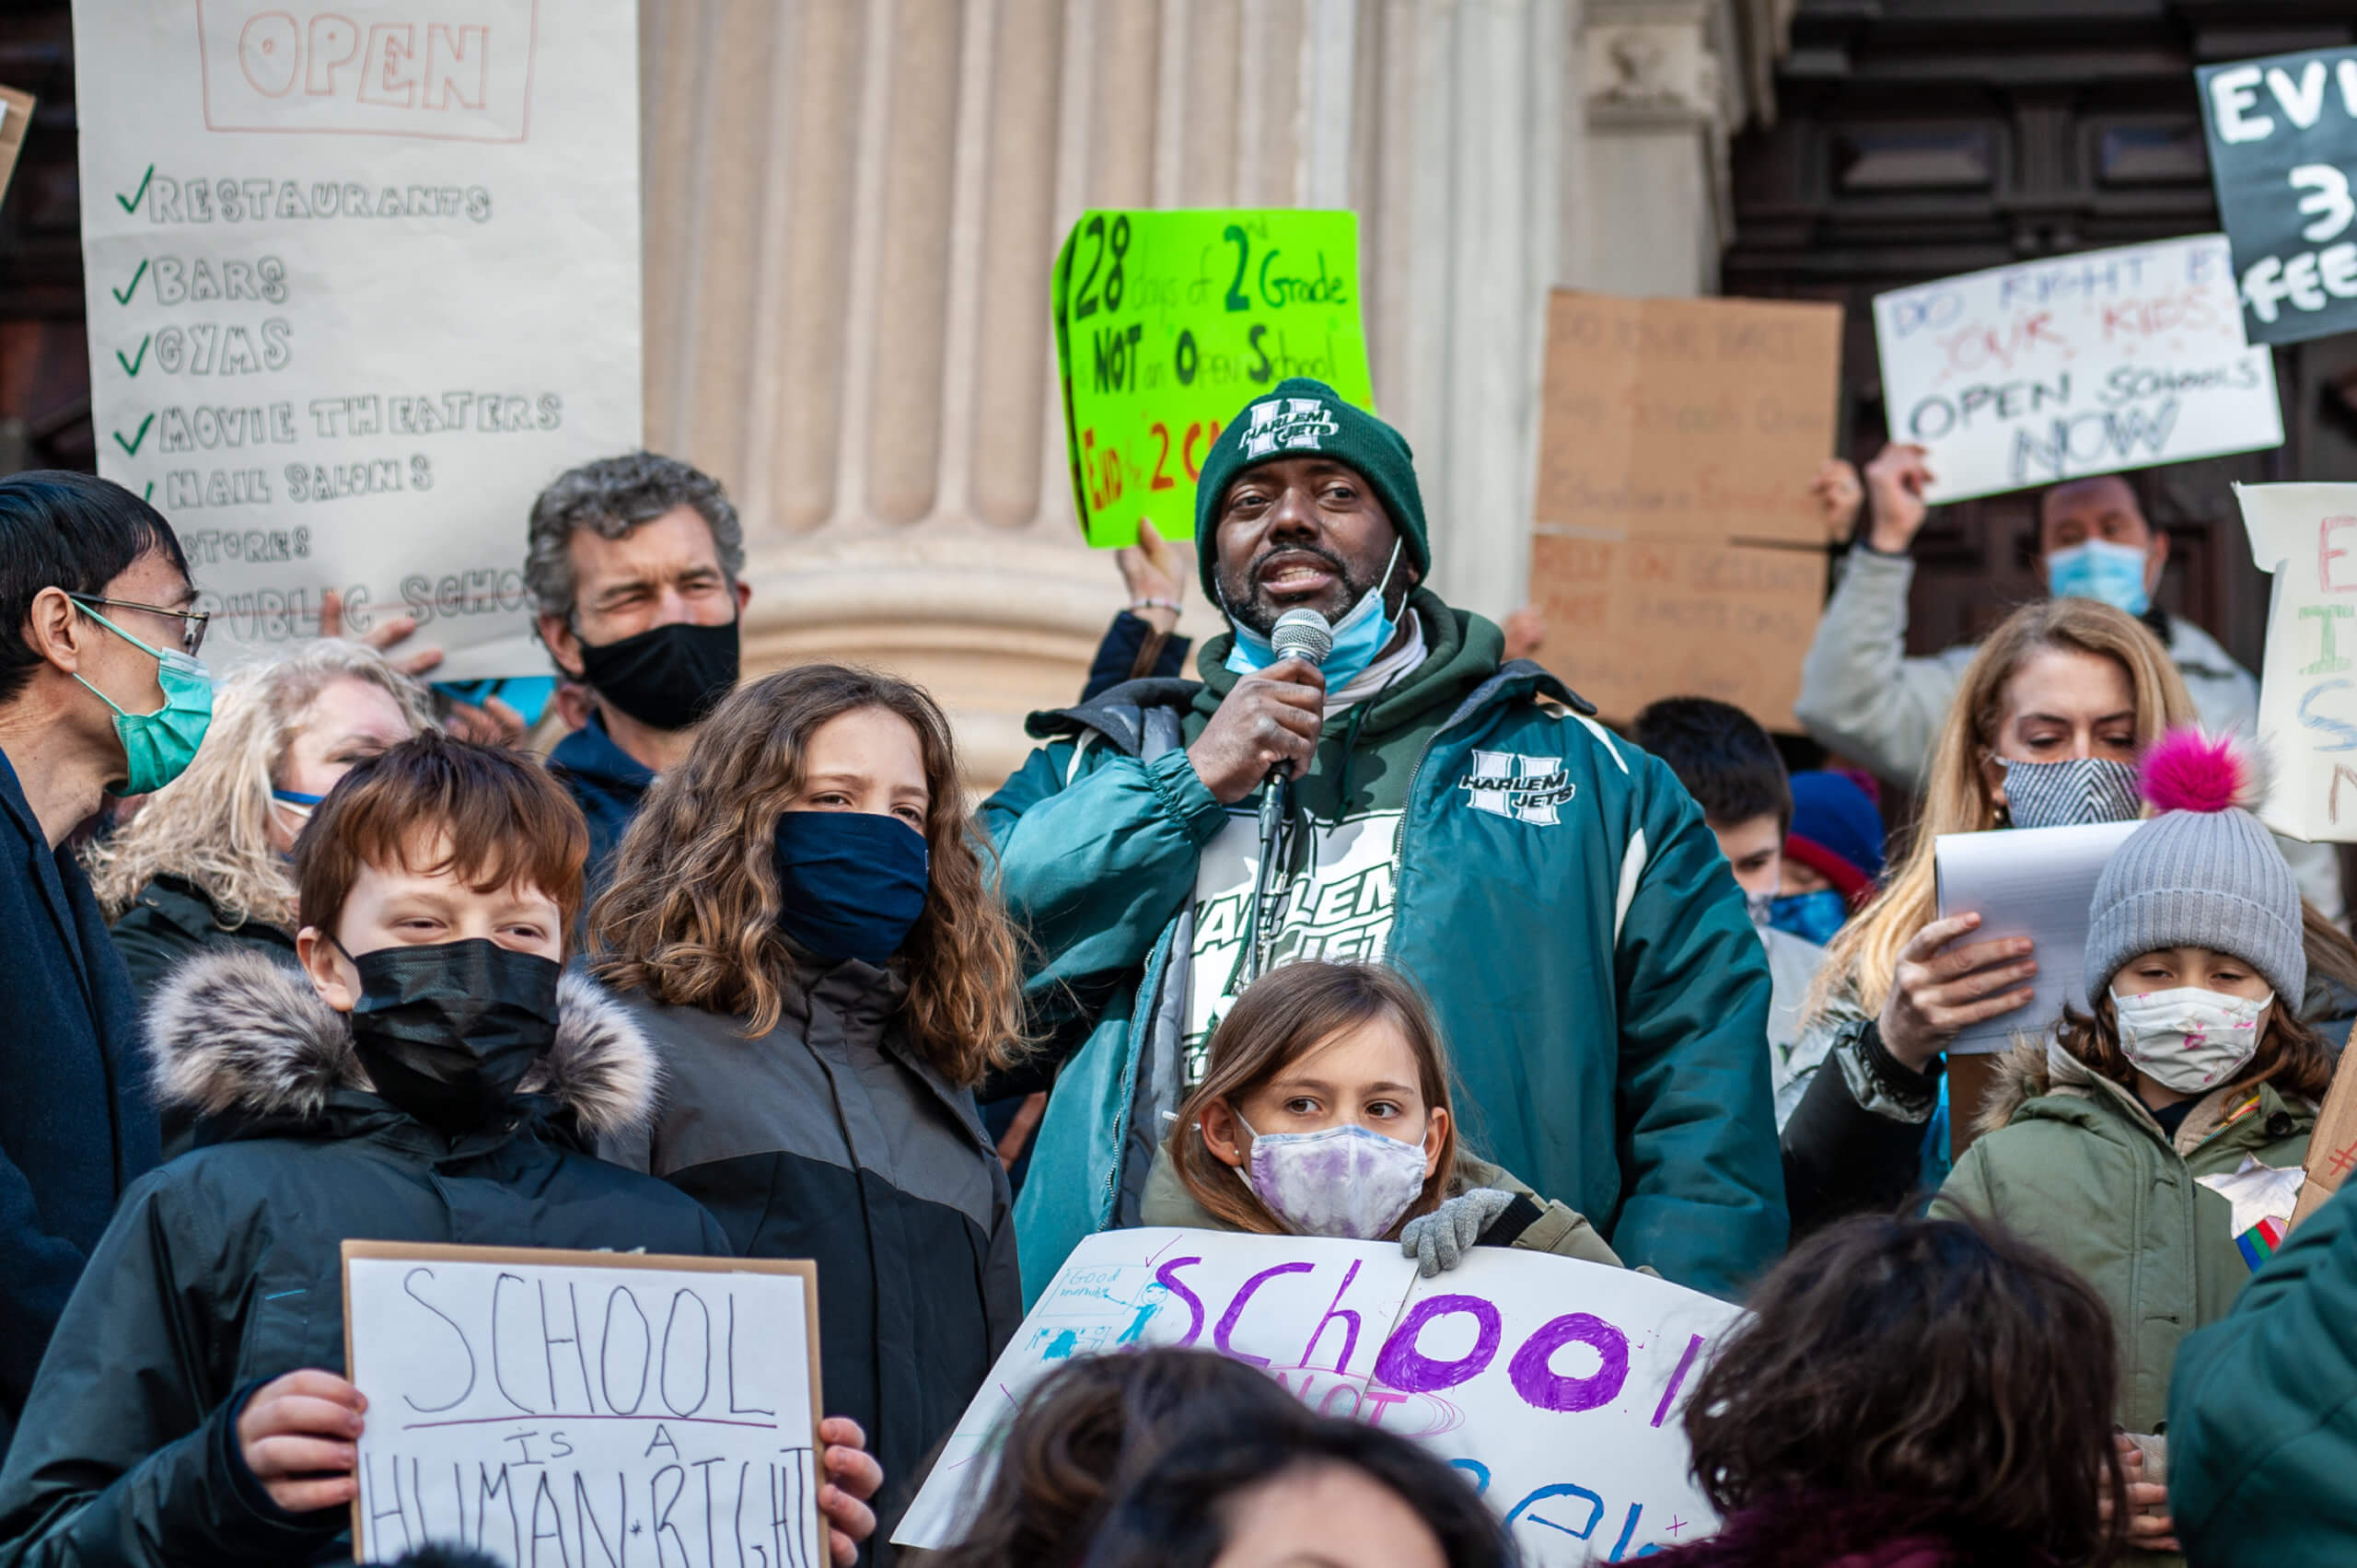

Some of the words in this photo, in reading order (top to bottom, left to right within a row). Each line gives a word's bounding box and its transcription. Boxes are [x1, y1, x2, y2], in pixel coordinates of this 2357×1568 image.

[239, 10, 489, 111] OPEN
[149, 176, 493, 223] RESTAURANTS
[2289, 163, 2354, 242] 3
[153, 255, 289, 306] BARS
[1075, 215, 1132, 321] 28
[1259, 249, 1348, 309] Grade
[155, 319, 292, 375] GYMS
[1094, 323, 1143, 396] NOT
[158, 402, 297, 453] MOVIE
[309, 390, 563, 440] THEATERS
[1237, 409, 1331, 449] HARLEM
[1278, 422, 1340, 443] JETS
[1909, 370, 2071, 441] OPEN
[1150, 421, 1176, 493] 2
[2011, 398, 2179, 483] NOW
[166, 465, 272, 510] NAIL
[180, 526, 310, 568] STORES
[193, 575, 371, 643] PUBLC
[400, 567, 540, 627] SCHO
[1458, 769, 1569, 793] HARLEM
[1511, 784, 1576, 809] JETS
[403, 1267, 775, 1418] SCHOOL
[504, 1428, 575, 1467] IS
[644, 1423, 679, 1460] A
